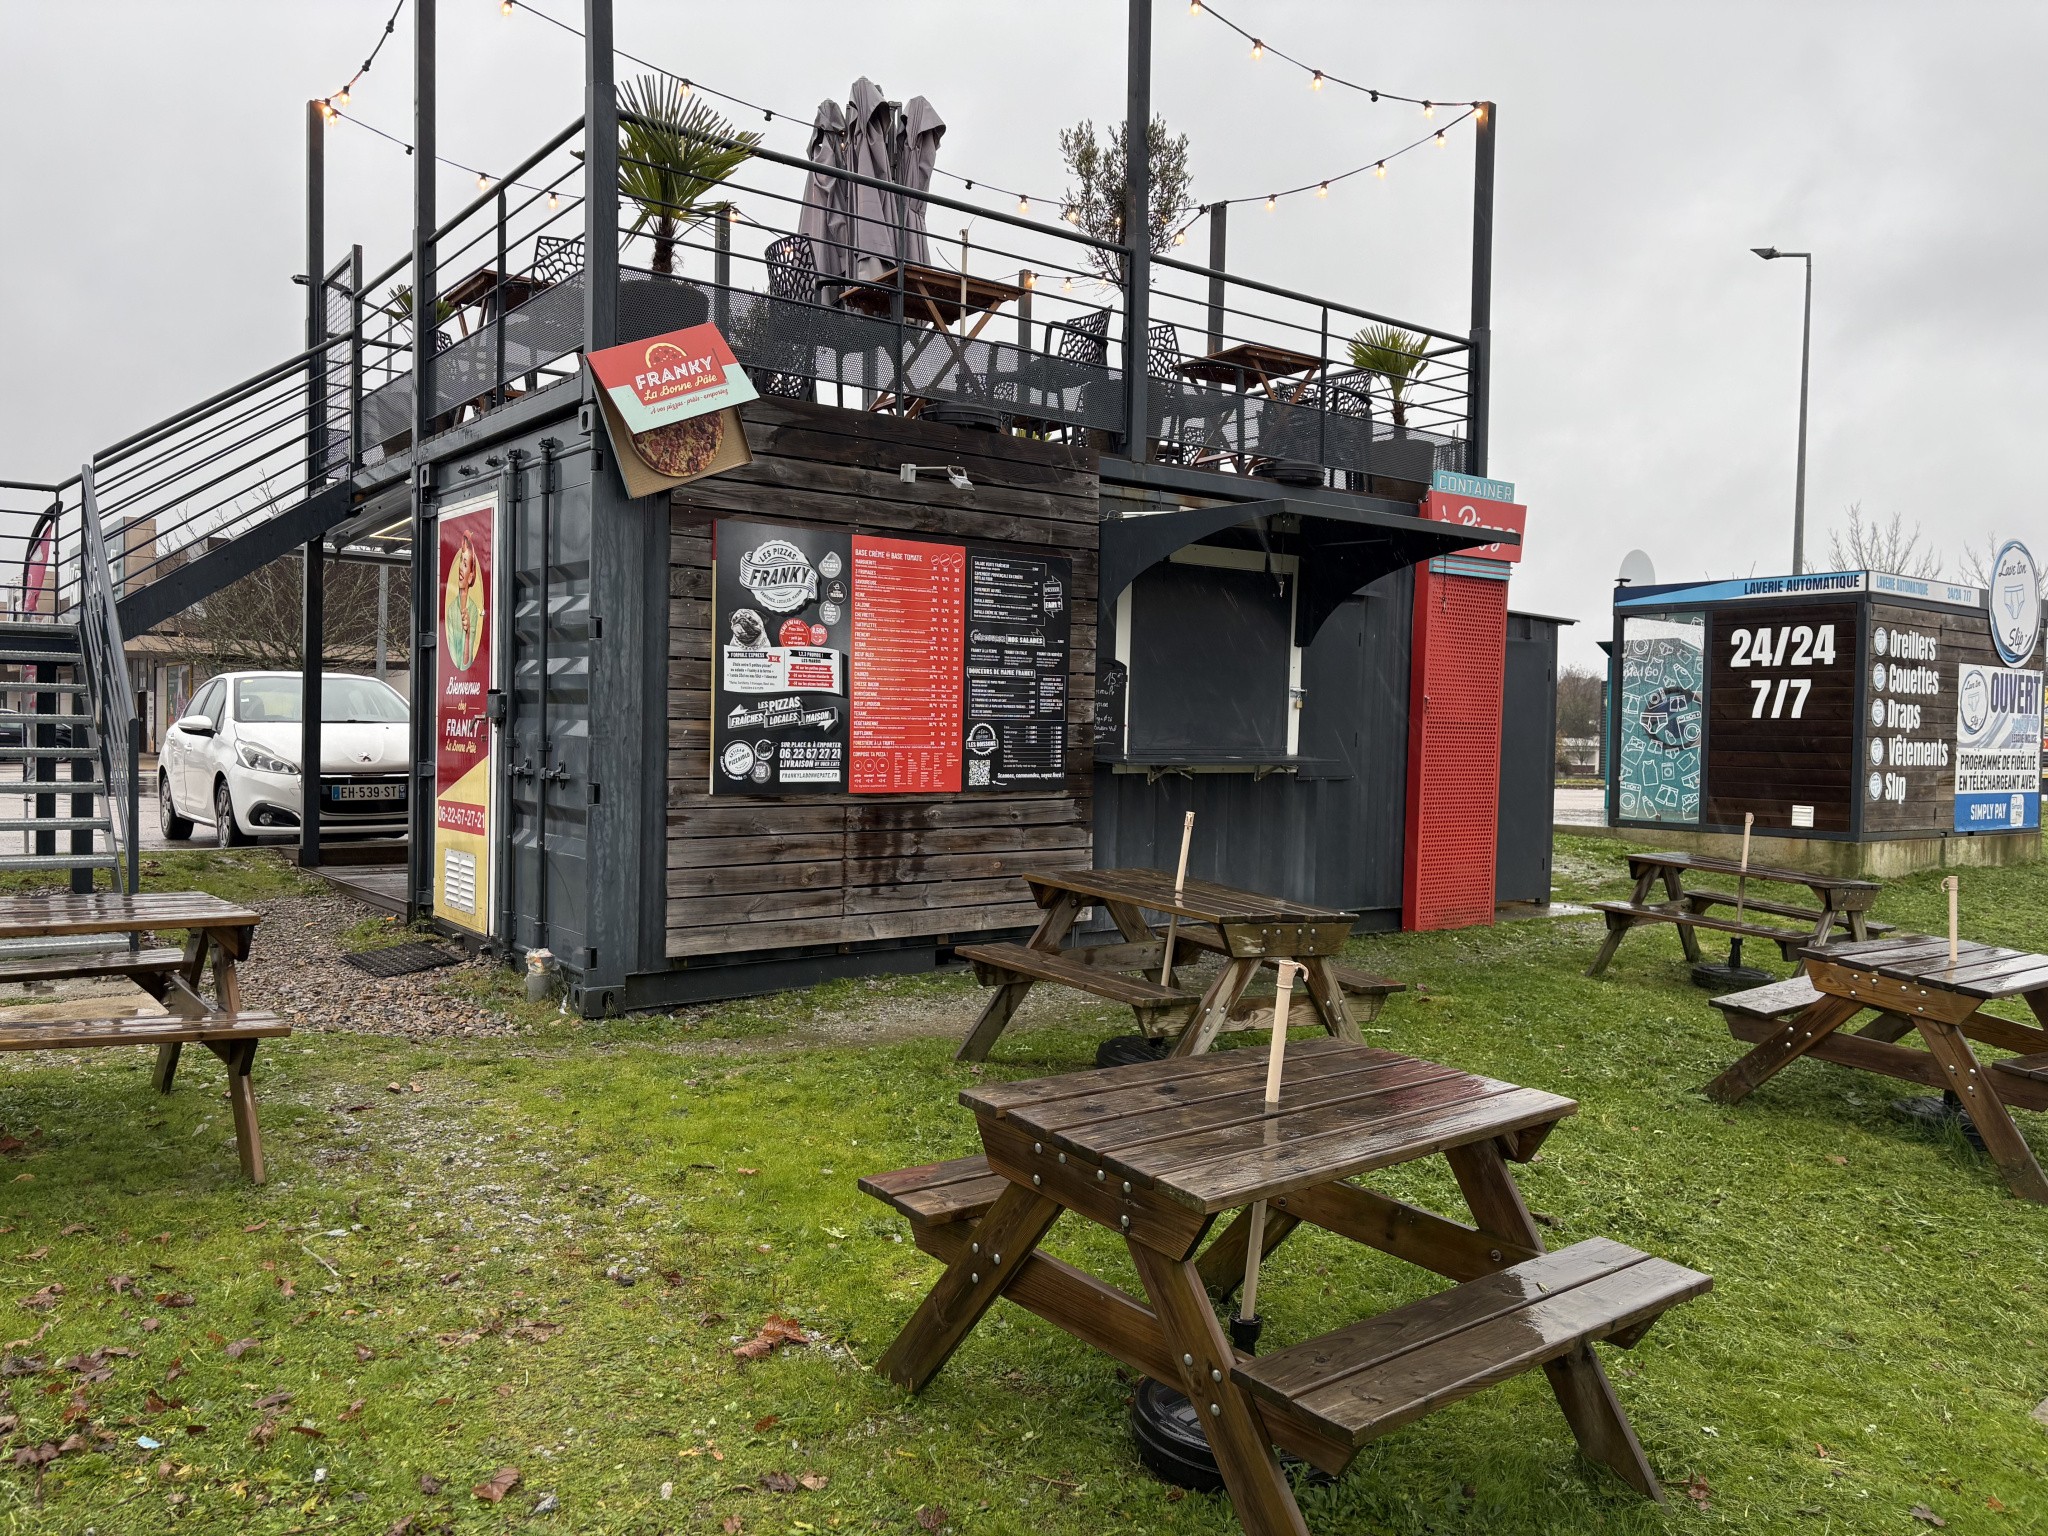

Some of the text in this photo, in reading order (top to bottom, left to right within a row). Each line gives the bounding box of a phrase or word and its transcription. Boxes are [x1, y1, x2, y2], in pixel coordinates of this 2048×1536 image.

[635, 356, 711, 390] FRANKY
[644, 374, 718, 401] La Bonne Pâte
[667, 401, 684, 410] pizzas
[1439, 475, 1512, 500] CONTAINER
[760, 548, 797, 563] LES PIZZAS
[868, 549, 885, 558] CRÈME
[749, 566, 811, 587] FRANKY
[1998, 559, 2027, 577] Lave ton
[1744, 574, 1860, 595] LAVERIE AUTOMATIQUE
[1876, 575, 1896, 591] LAVERIE
[1896, 578, 1929, 596] AUTOMATIQUE
[1730, 624, 1836, 668] 24/24
[1890, 629, 1937, 661] Oreillers
[2009, 628, 2024, 652] Slip
[446, 676, 481, 695] Bienvenue
[1888, 663, 1939, 695] Couettes
[1750, 679, 1812, 719] 7/7
[1990, 672, 2041, 714] OUVERT
[757, 696, 801, 712] LES PIZZAS
[731, 710, 830, 726] FRAÎCHES LOCALES MAISON
[1887, 699, 1921, 733] Draps
[780, 748, 841, 759] 06 22 67 27 21
[1888, 734, 1949, 767] Vêtements
[1960, 751, 2036, 770] PROGRAMME DE FIDÉLITÉ
[780, 760, 814, 768] LIVRAISON
[1885, 772, 1907, 805] Slip
[1959, 771, 2036, 791] EN TÉLÉCHARGEANT AVEC
[341, 786, 397, 799] EH-539-ST
[438, 805, 486, 829] 06-22-67-27-21
[1970, 803, 2007, 820] SIMPLY PAY
